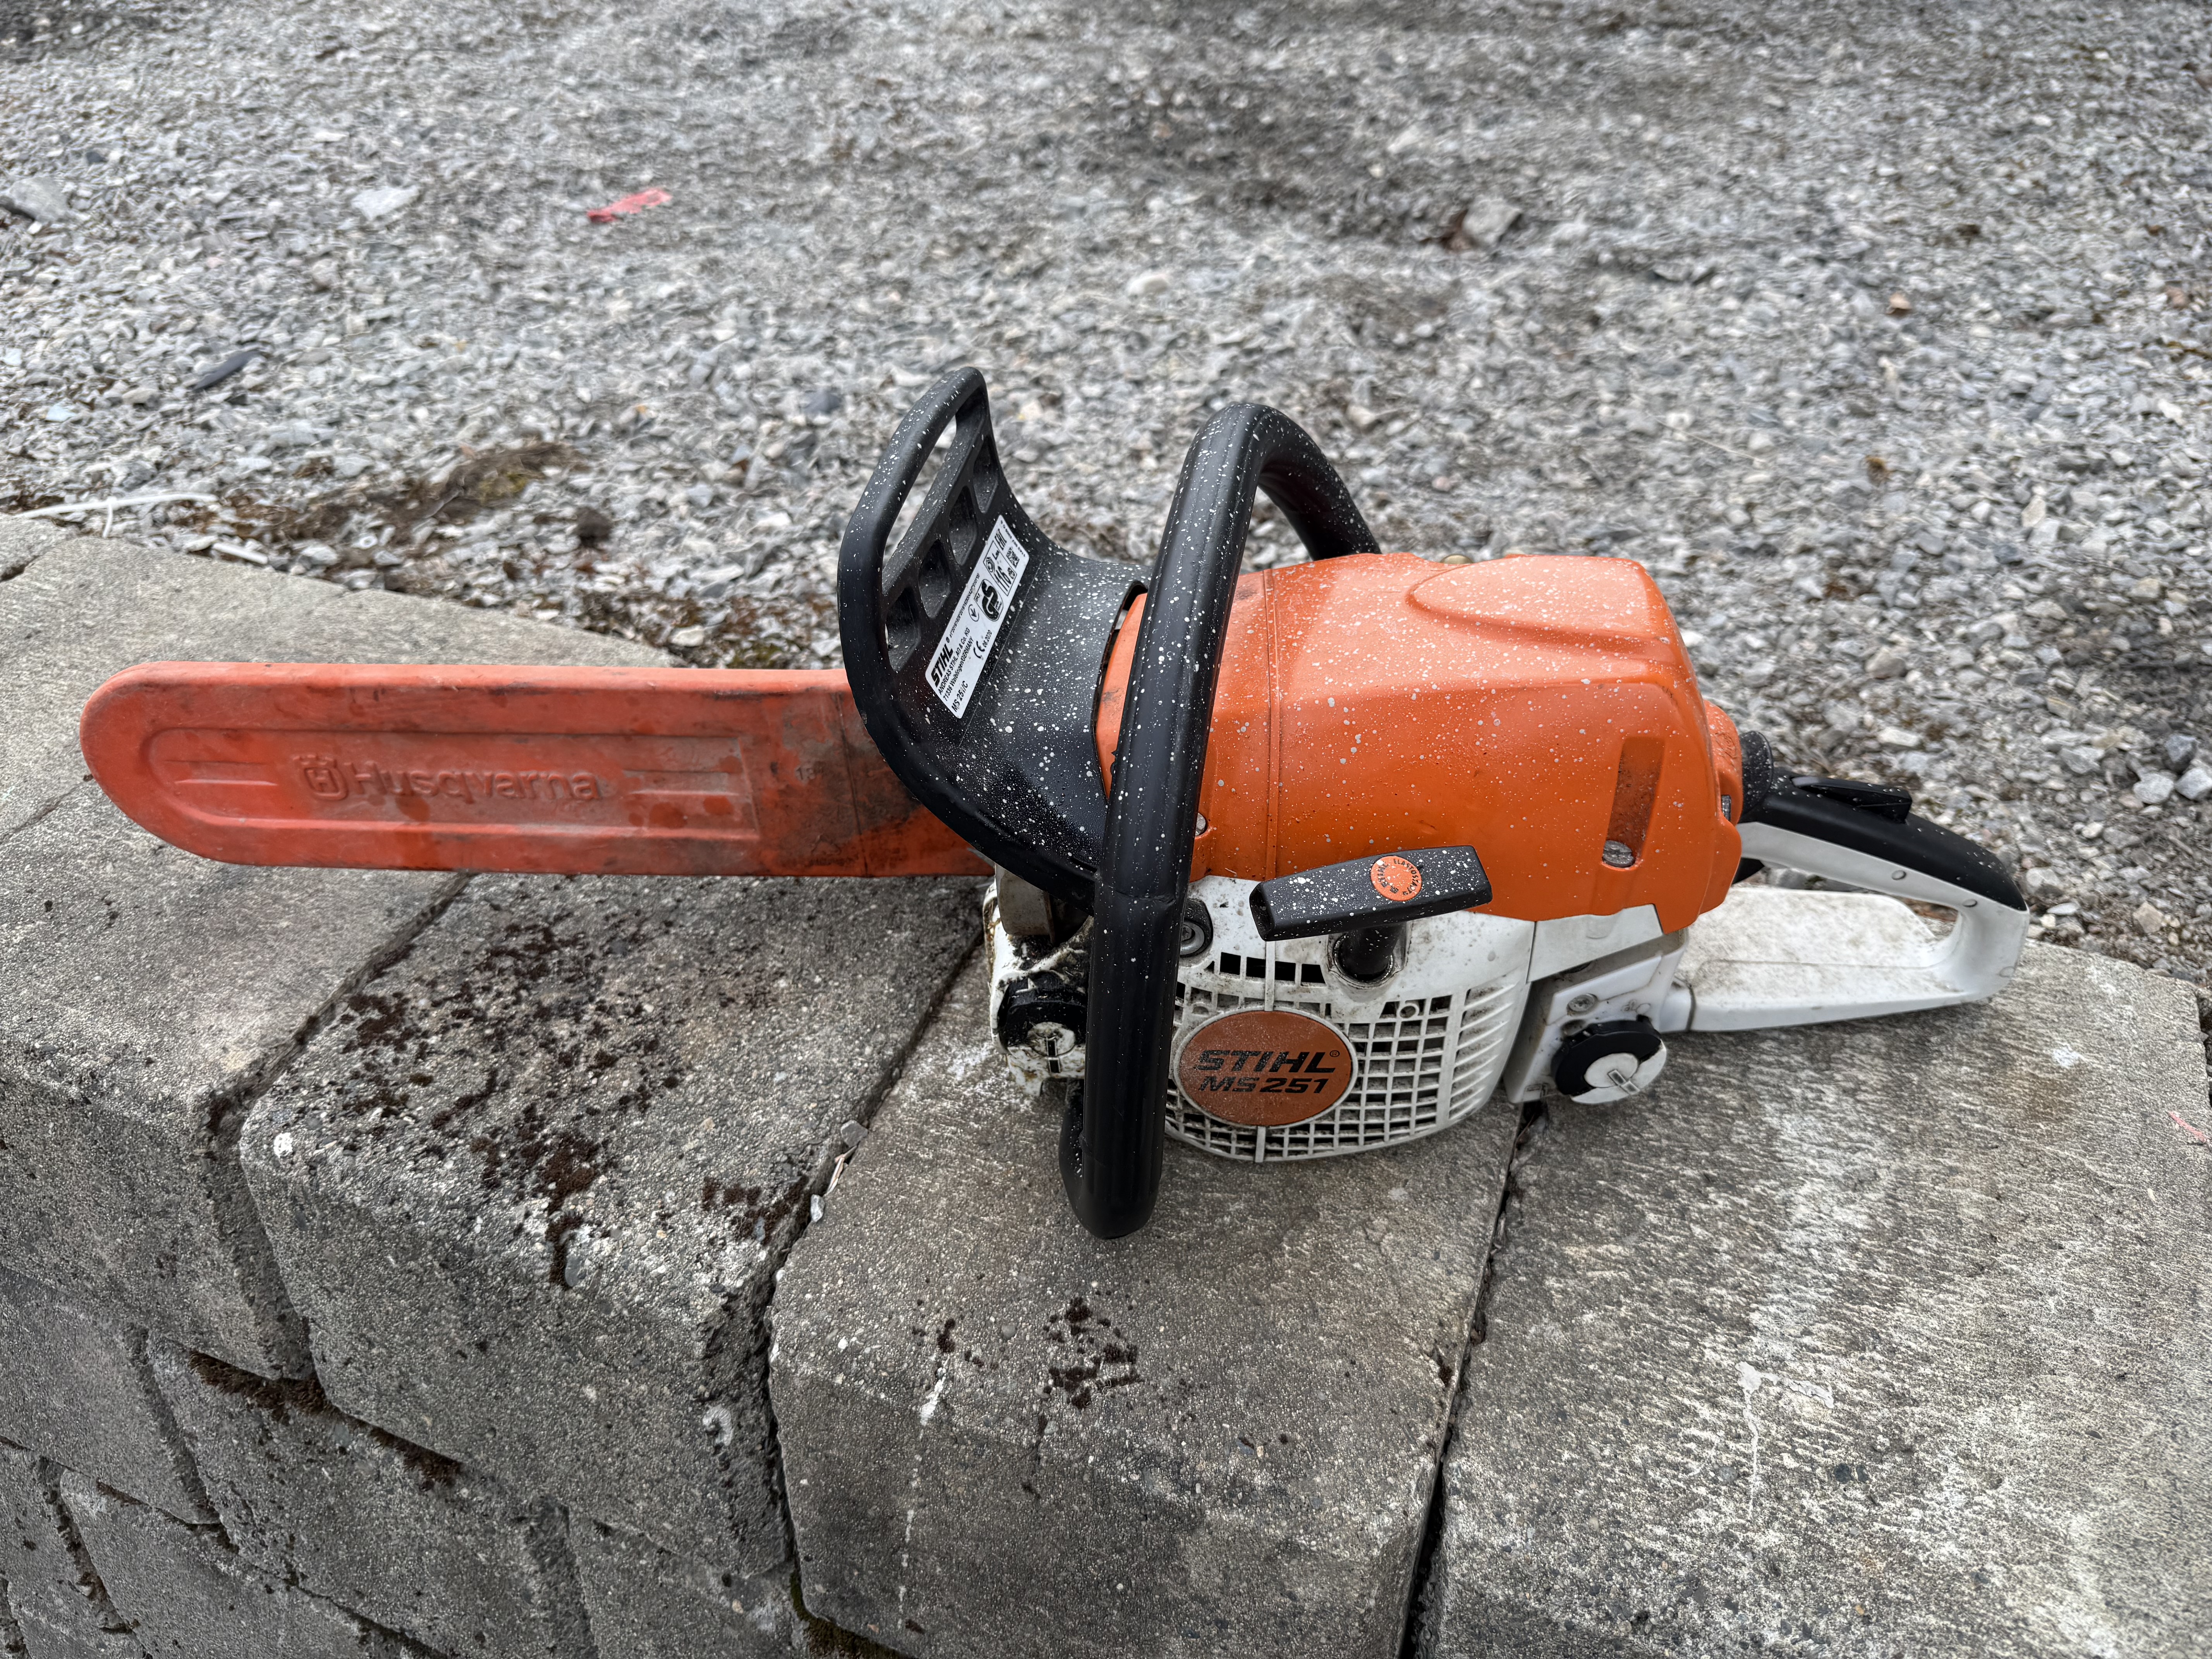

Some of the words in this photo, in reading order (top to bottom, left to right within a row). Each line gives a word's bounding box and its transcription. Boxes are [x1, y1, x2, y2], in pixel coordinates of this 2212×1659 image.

[994, 566, 1012, 592] 116
[938, 669, 951, 695] ANDREAS
[949, 656, 958, 670] STIHL
[956, 647, 961, 656] AG
[964, 627, 970, 637] KG
[943, 685, 953, 701] 71336
[951, 699, 960, 712] MS
[344, 761, 600, 804] Husqvarna
[1199, 1076, 1260, 1093] MS
[1259, 1078, 1329, 1094] 251
